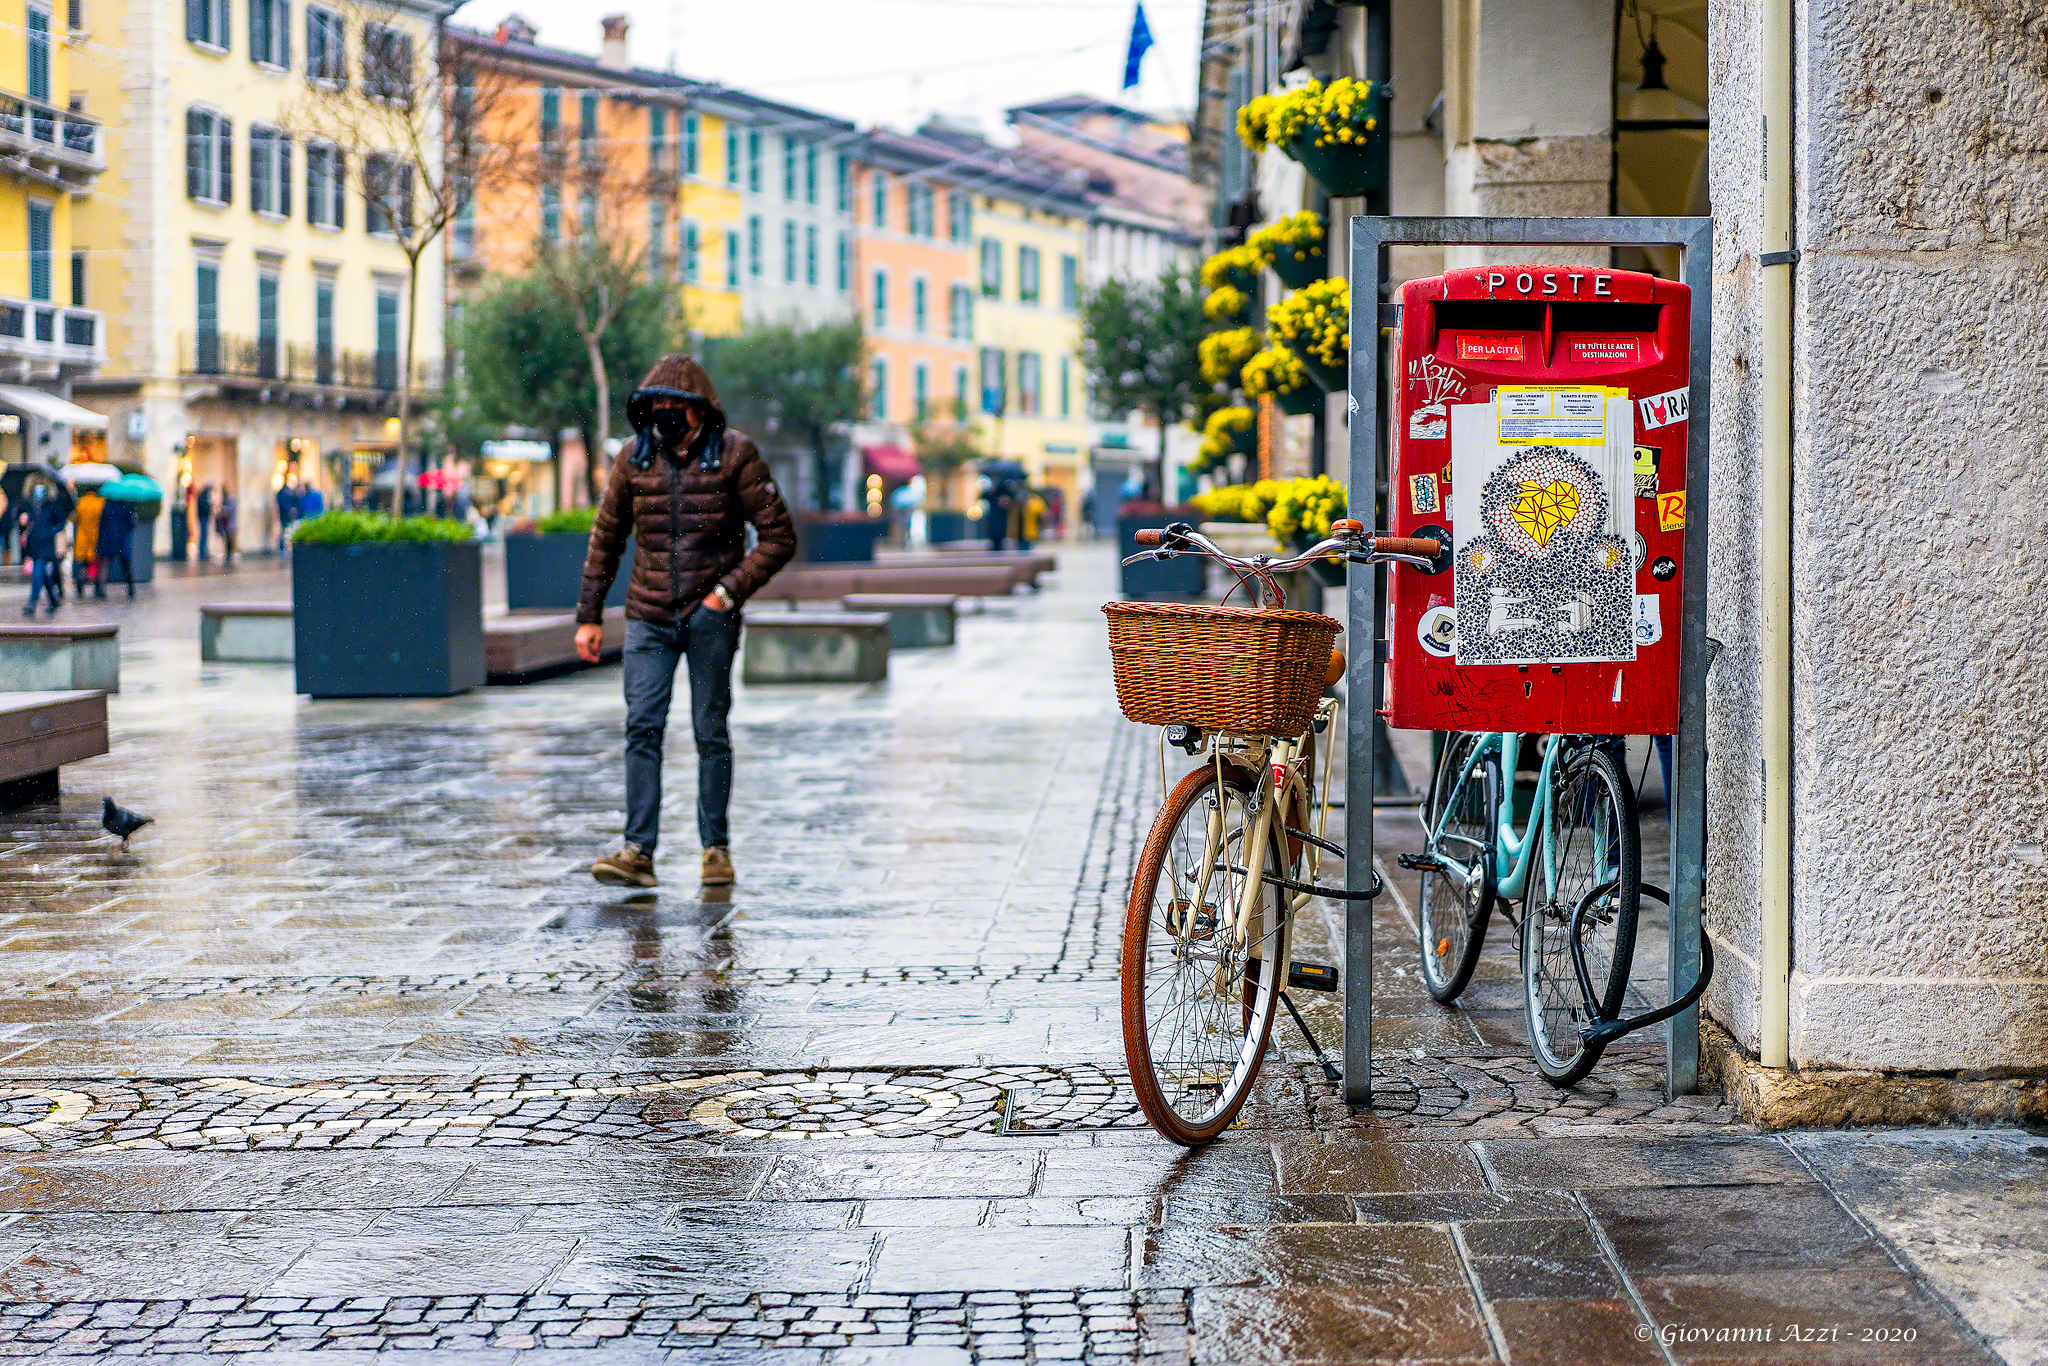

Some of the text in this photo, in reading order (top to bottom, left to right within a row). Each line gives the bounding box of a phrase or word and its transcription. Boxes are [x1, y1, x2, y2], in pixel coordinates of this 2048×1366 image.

[1488, 272, 1612, 296] POSTE
[1468, 345, 1520, 355] PER LA CITTÀ
[1574, 342, 1634, 350] PER TUTTE LE ALTRE
[1581, 350, 1628, 359] DESTINAZIONI
[1644, 402, 1652, 425] I
